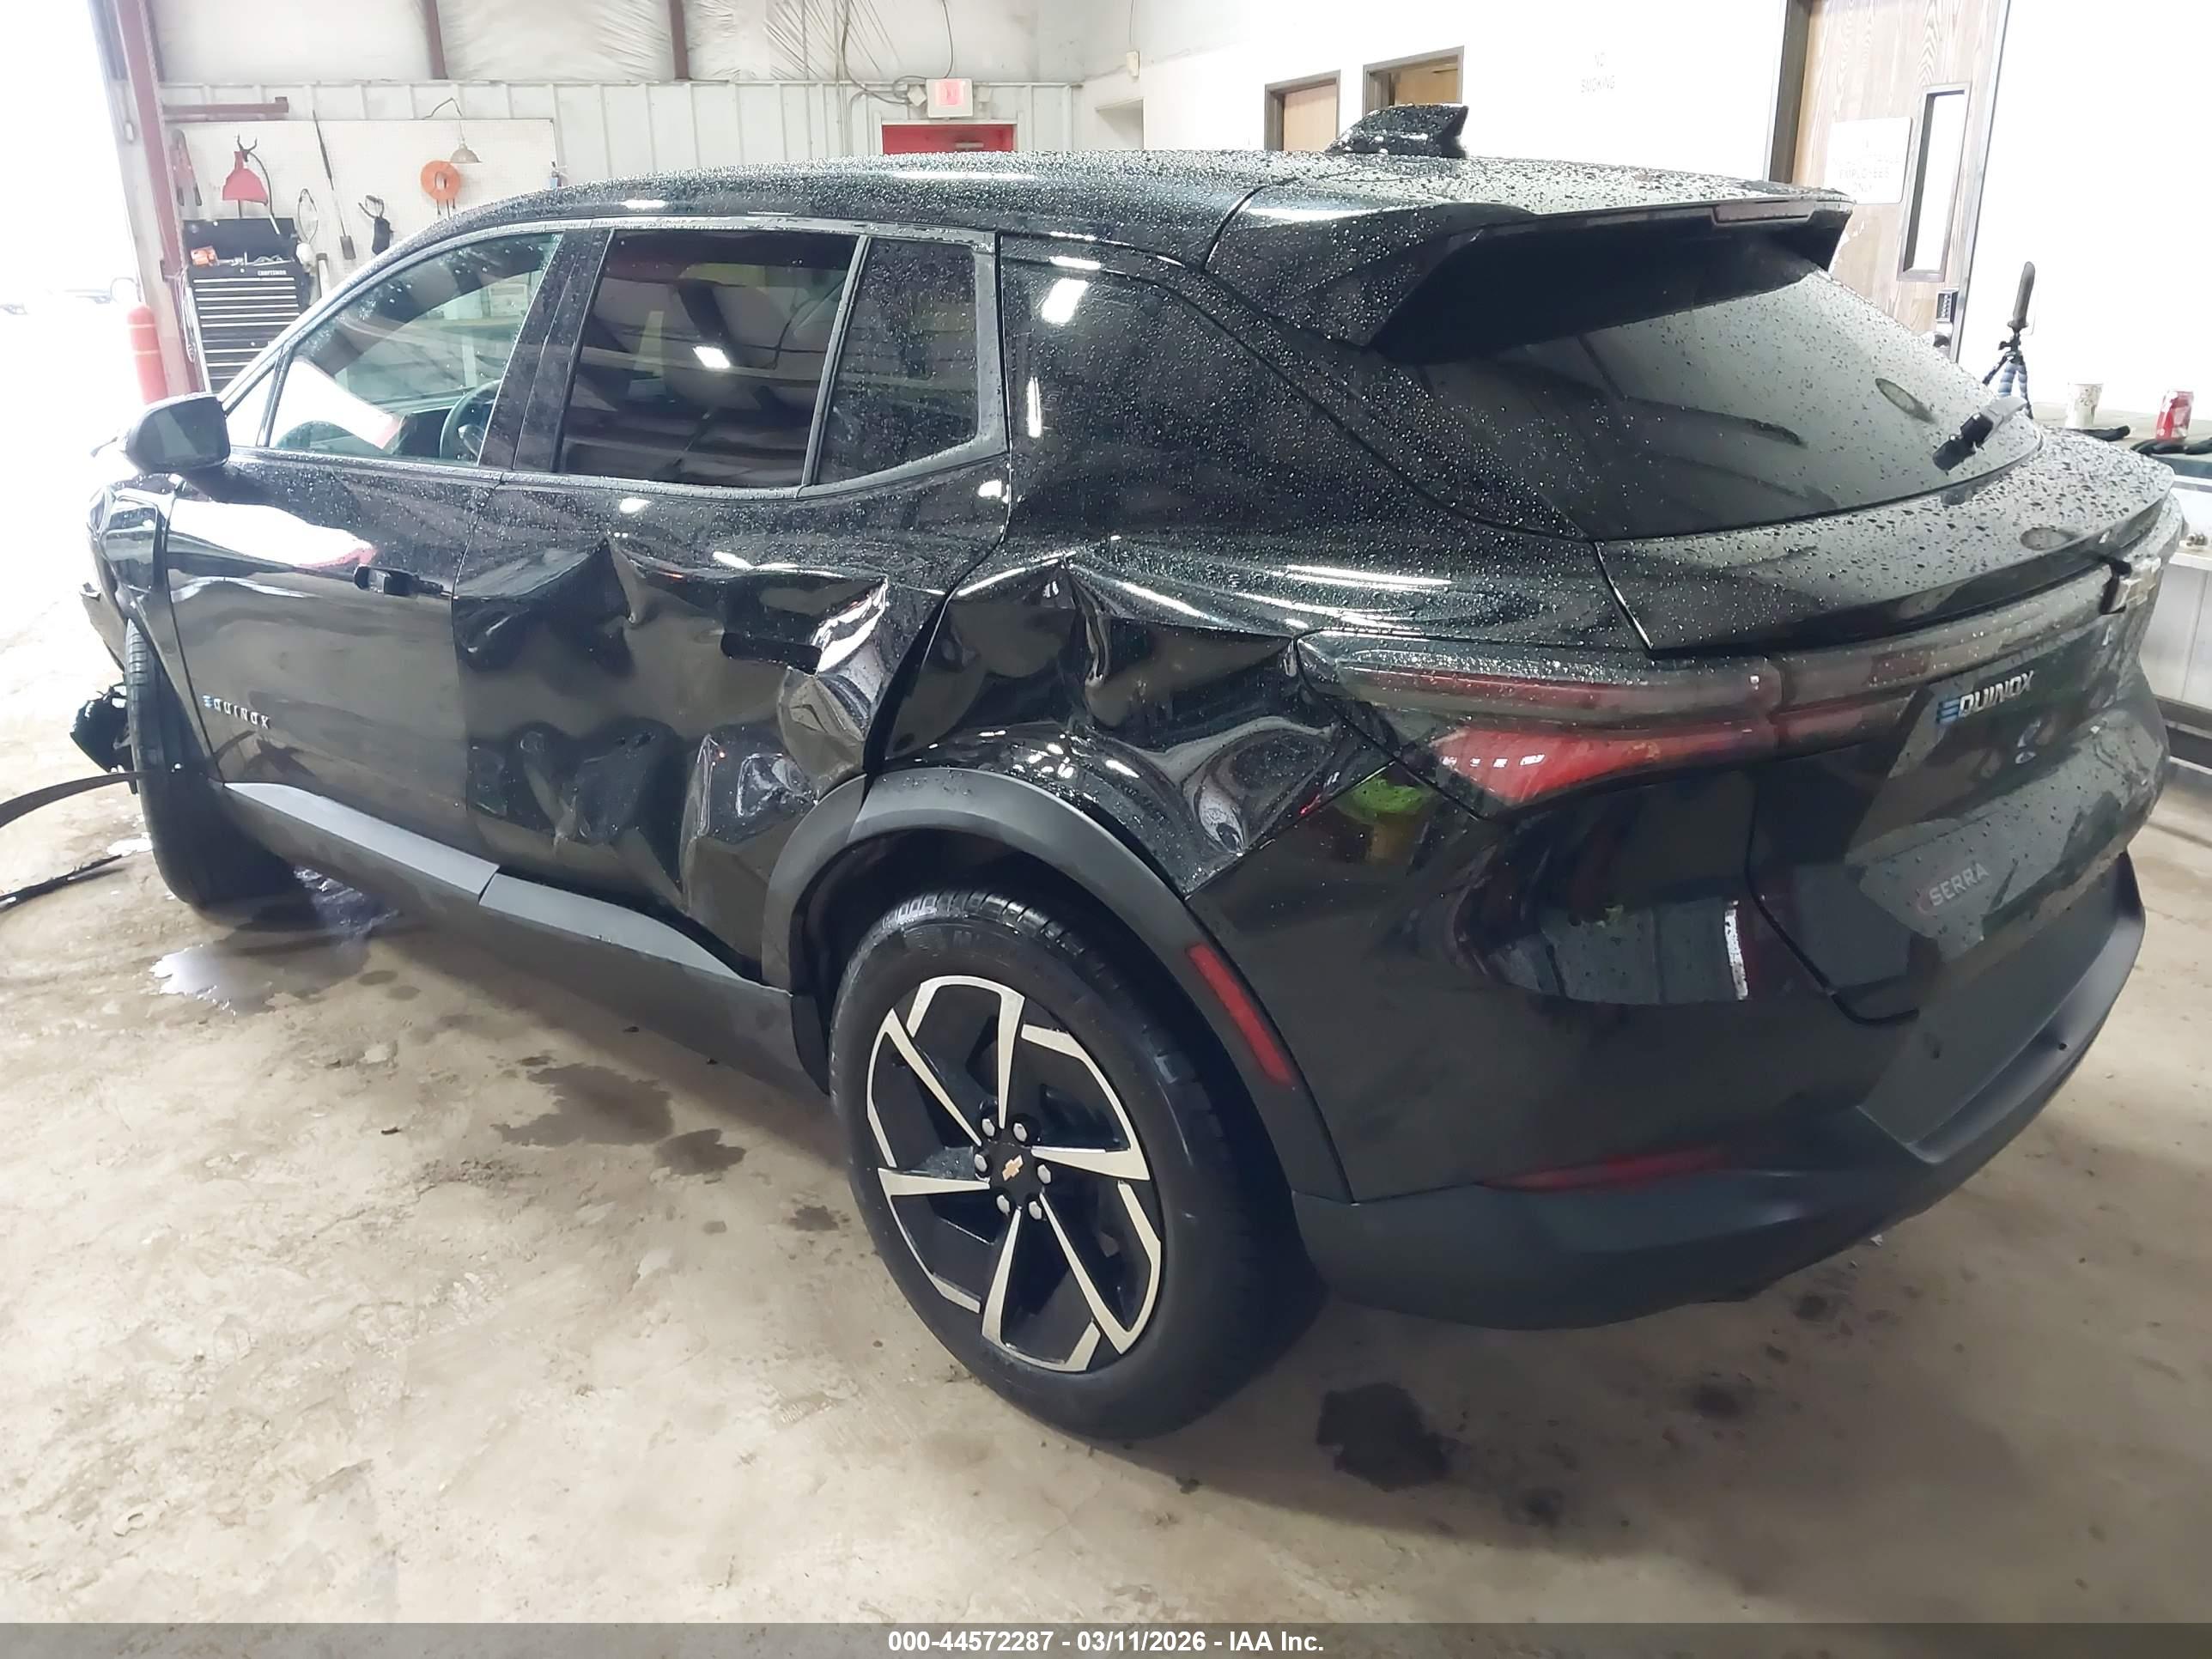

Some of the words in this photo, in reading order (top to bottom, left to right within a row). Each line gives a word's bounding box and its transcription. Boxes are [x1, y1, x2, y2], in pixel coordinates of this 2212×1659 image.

[203, 695, 270, 730] EQUINOX
[1936, 670, 2034, 724] EQUINOX
[1929, 863, 1990, 907] SERRA
